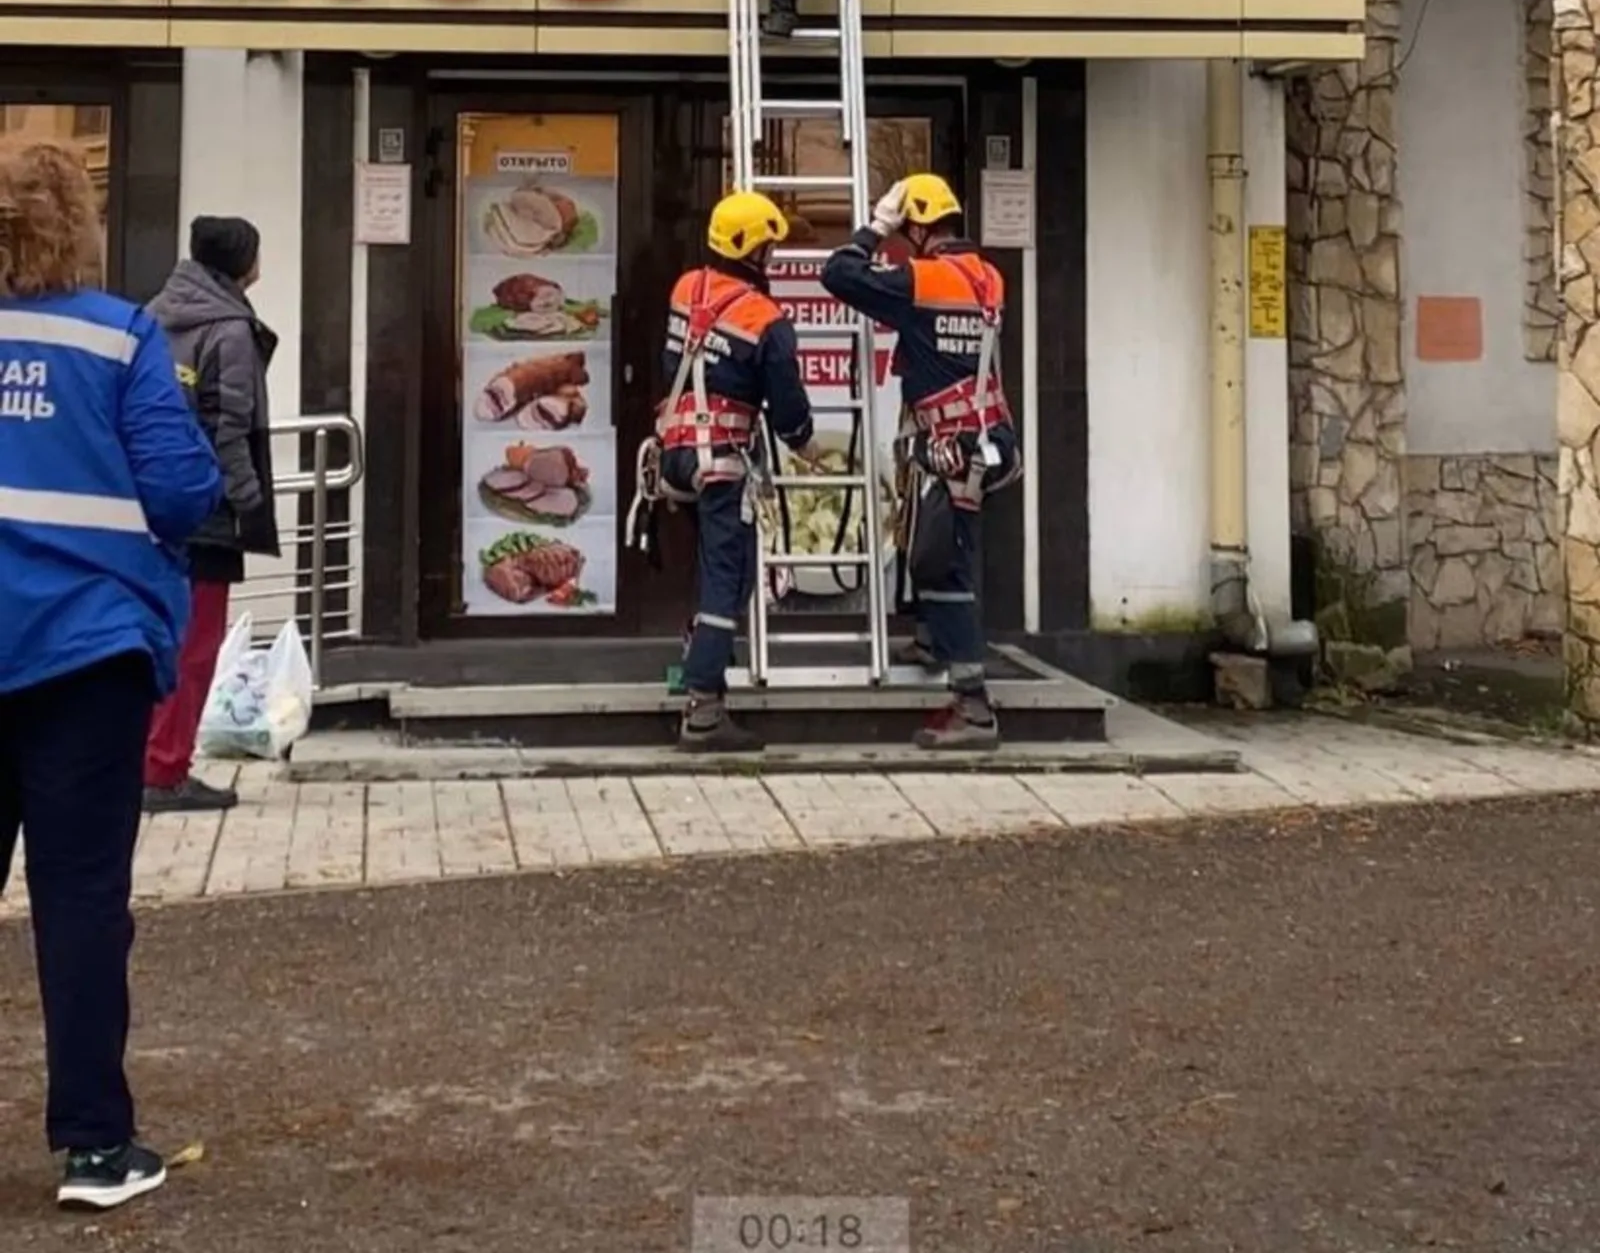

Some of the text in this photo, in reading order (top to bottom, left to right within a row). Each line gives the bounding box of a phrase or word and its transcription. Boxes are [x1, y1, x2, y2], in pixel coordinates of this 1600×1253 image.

[500, 156, 568, 168] ОТКРЫТО
[0, 359, 47, 387] АЯ
[0, 390, 56, 423] ЩЬ
